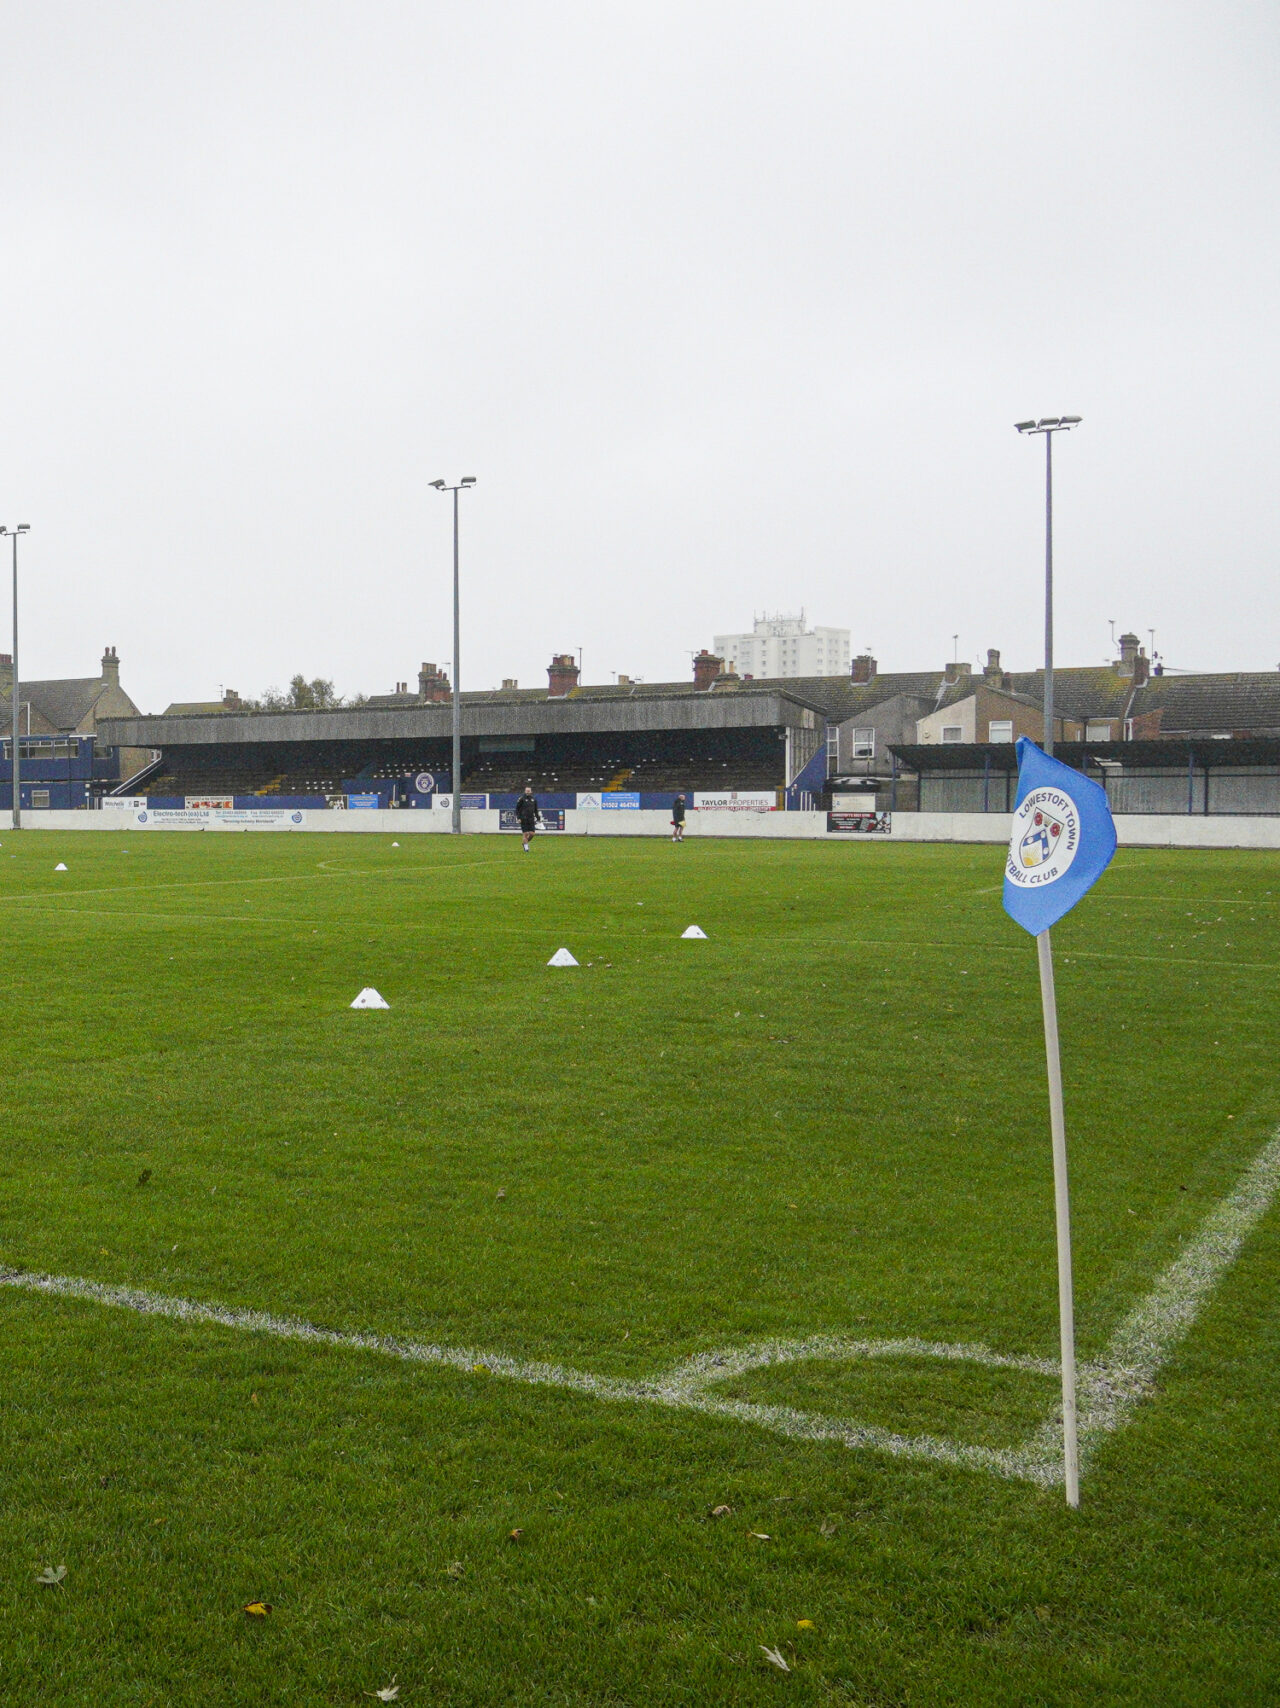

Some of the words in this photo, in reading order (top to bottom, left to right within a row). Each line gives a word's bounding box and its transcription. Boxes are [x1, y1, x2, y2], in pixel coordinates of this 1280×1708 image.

[1019, 792, 1069, 819] LOWESTOFT
[1065, 810, 1075, 850] TOWN
[1030, 867, 1058, 883] CLUB
